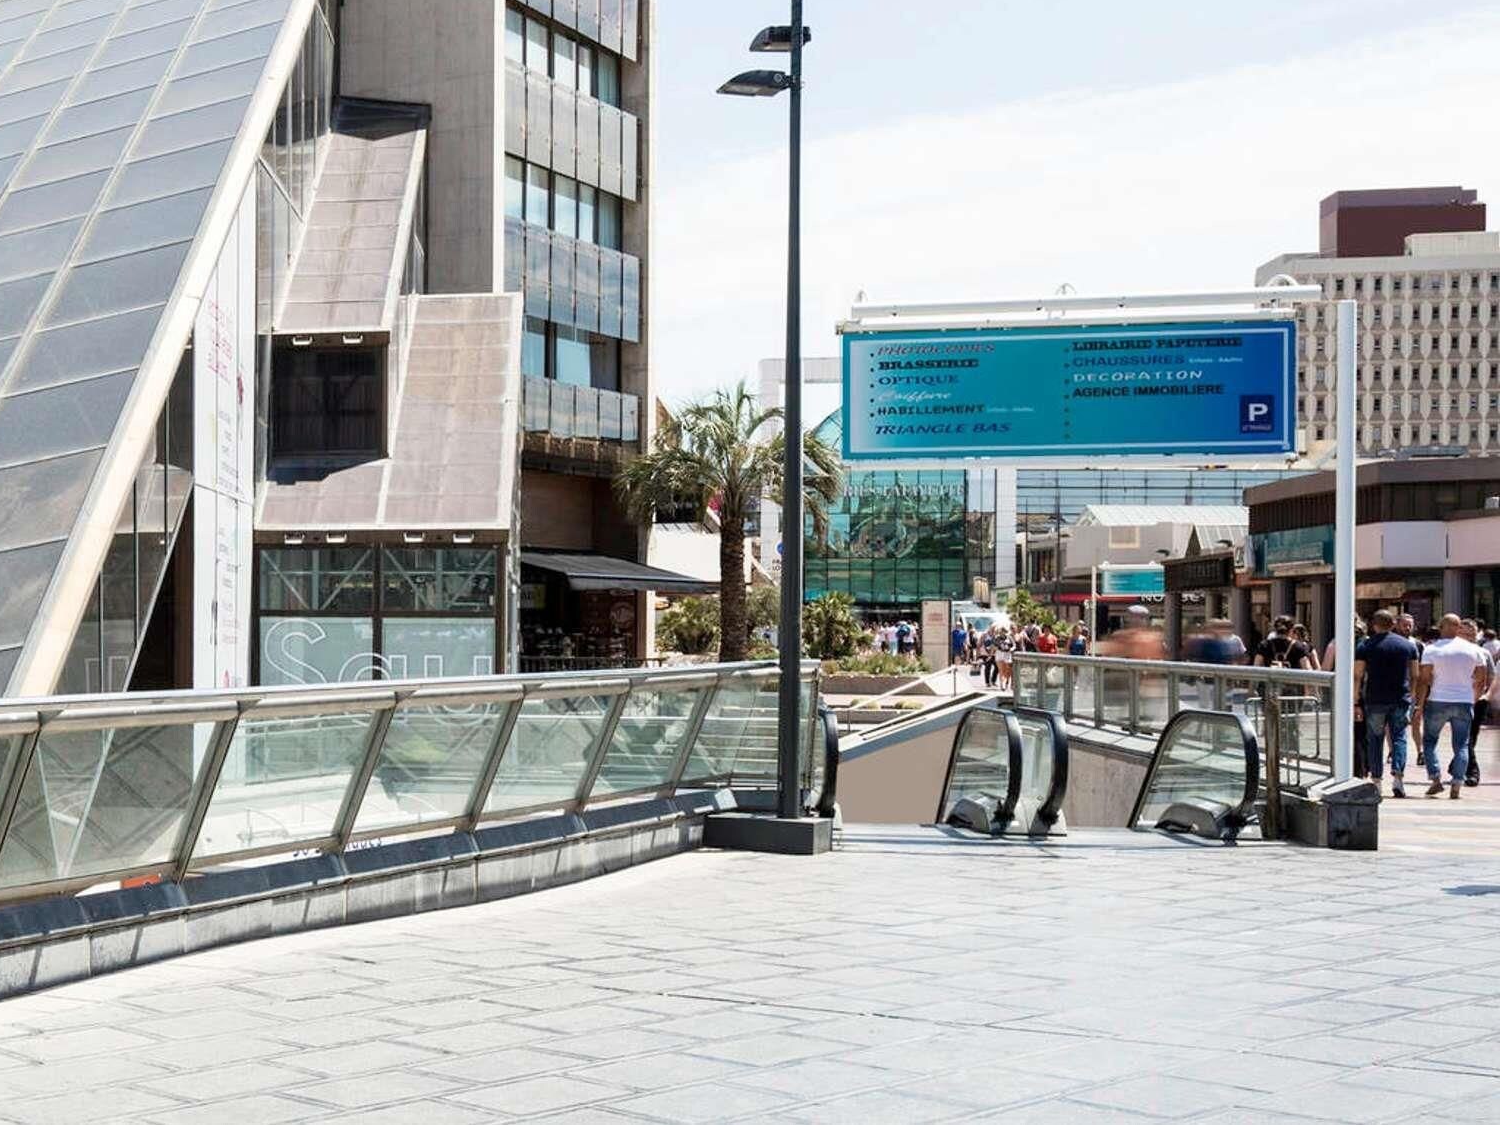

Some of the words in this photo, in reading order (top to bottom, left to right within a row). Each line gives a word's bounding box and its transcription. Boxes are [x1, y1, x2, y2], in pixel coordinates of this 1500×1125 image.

[878, 358, 980, 371] BRASSERIE
[1072, 354, 1185, 367] CHAUSSURES
[878, 374, 960, 386] OPTIQUE
[1073, 370, 1204, 383] DECORATION
[1072, 386, 1129, 399] AGENCE
[877, 403, 985, 416] HABILLEMENT
[1248, 403, 1269, 422] P
[875, 423, 965, 435] TRIANGLE
[973, 422, 1012, 434] BAS
